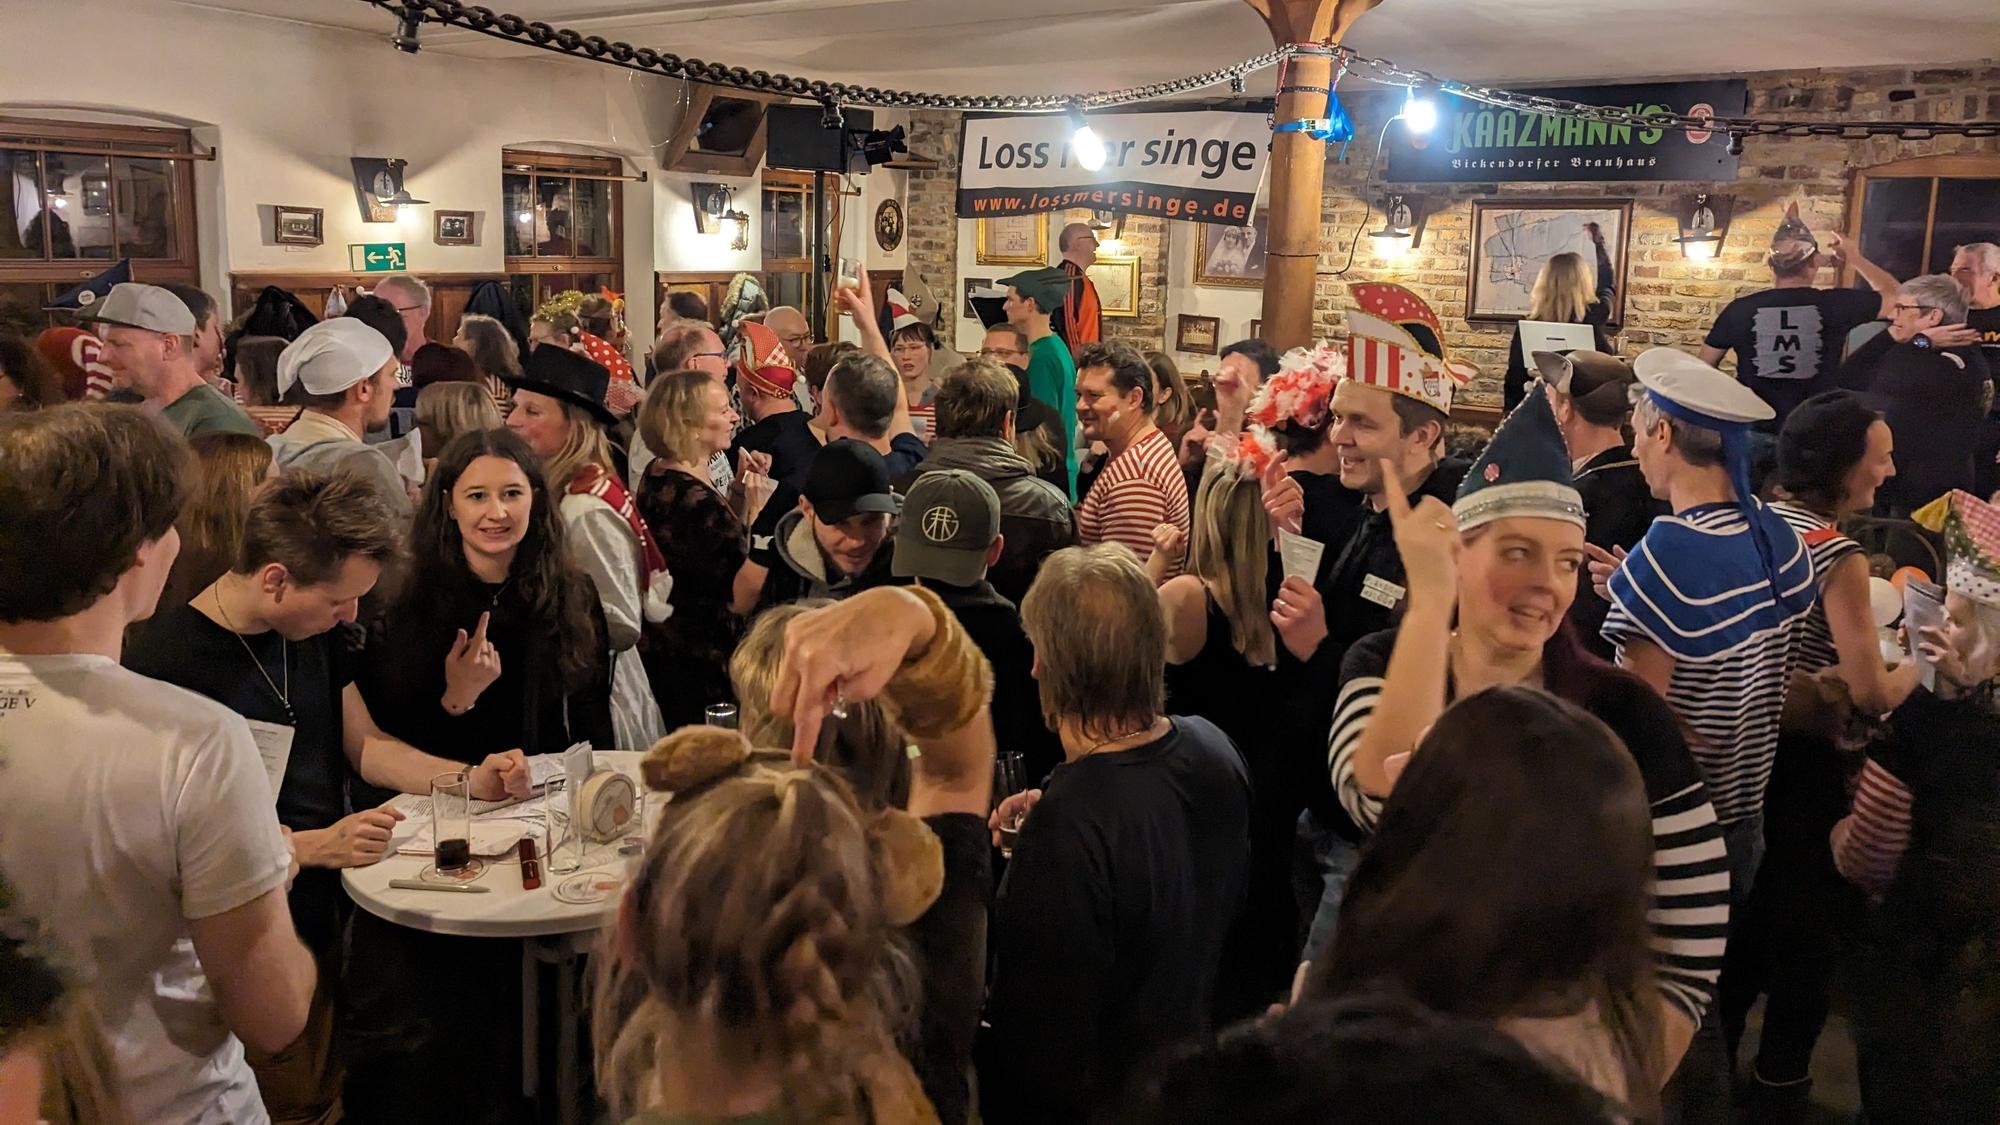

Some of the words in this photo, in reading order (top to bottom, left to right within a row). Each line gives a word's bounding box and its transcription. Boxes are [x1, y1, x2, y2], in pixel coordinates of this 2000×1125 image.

[978, 136, 1049, 170] Loss
[1140, 129, 1257, 180] singe
[1451, 157, 1561, 171] Bickendorfer
[1570, 156, 1657, 169] Brauhaus
[972, 189, 1247, 220] www.lossmersinge.de
